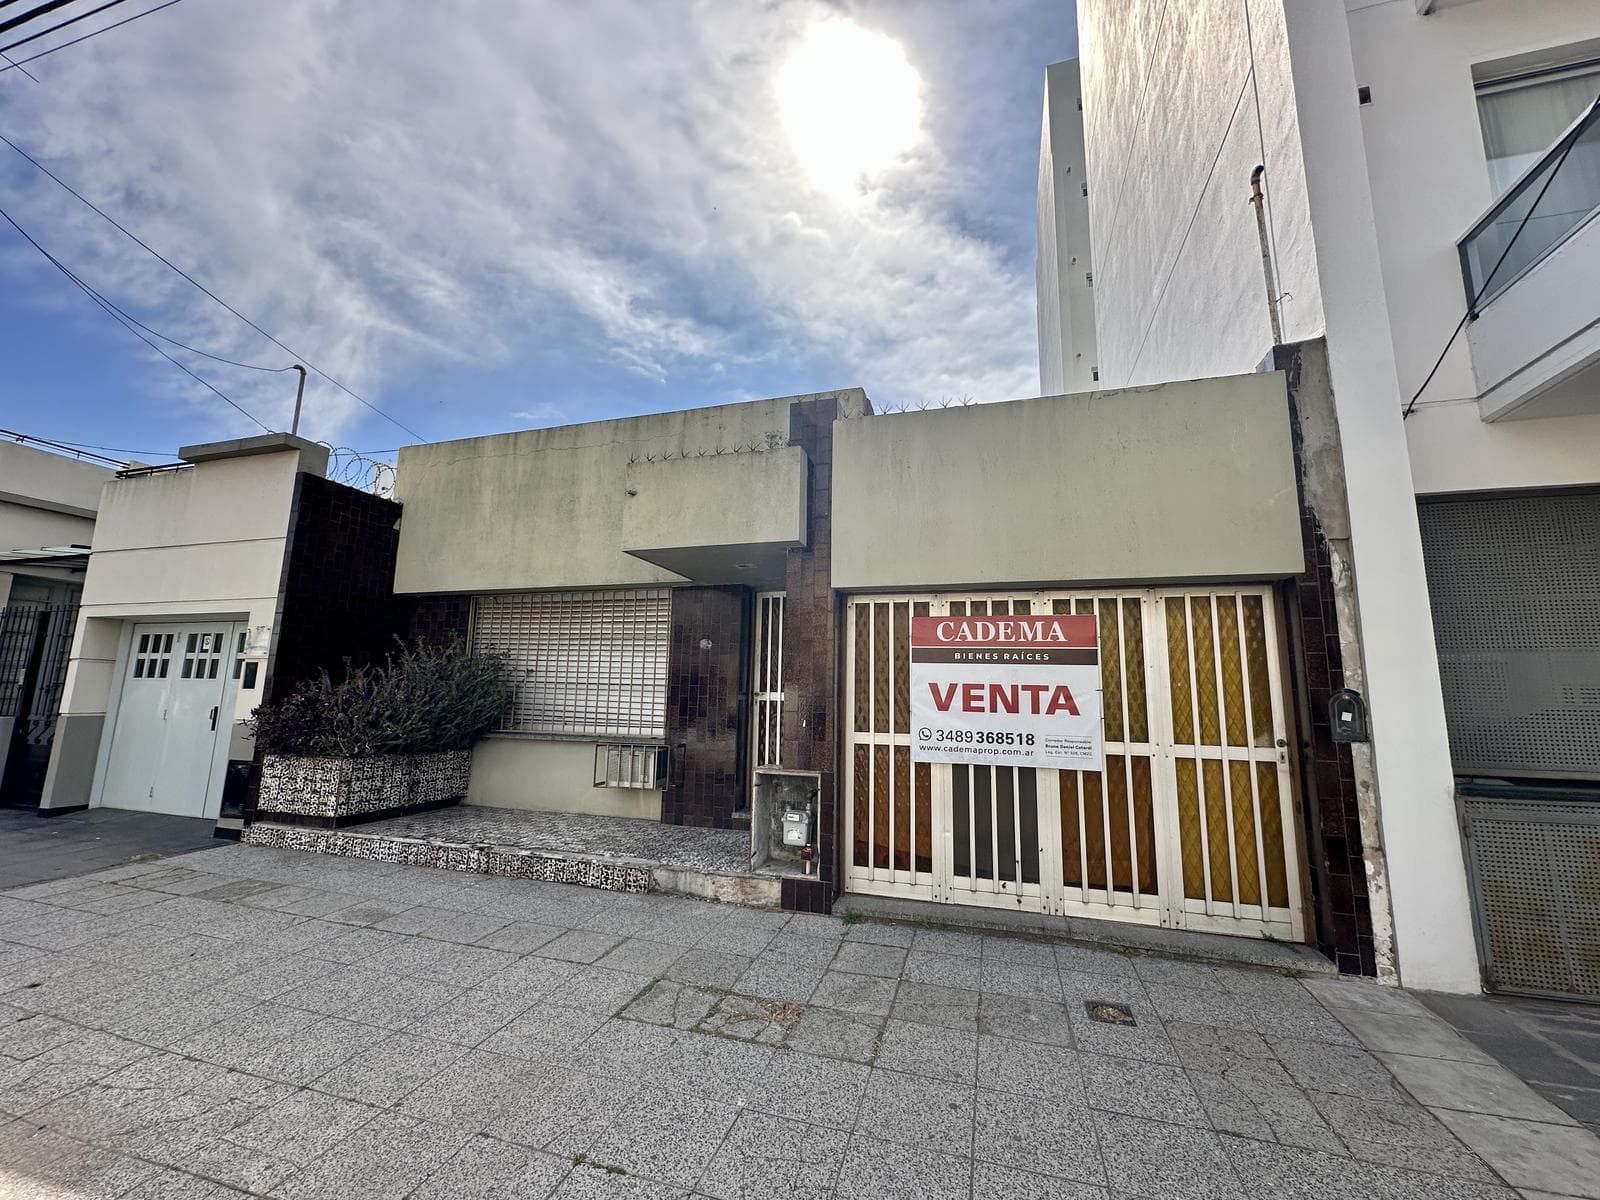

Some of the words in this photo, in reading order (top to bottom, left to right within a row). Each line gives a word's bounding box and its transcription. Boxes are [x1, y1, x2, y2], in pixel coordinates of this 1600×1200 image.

[936, 621, 1068, 642] CADEMA
[954, 652, 999, 660] BIENES
[1003, 651, 1050, 661] RAÍCES
[928, 682, 1081, 716] VENTA
[919, 745, 1034, 757] www.cademaprop.com.ar
